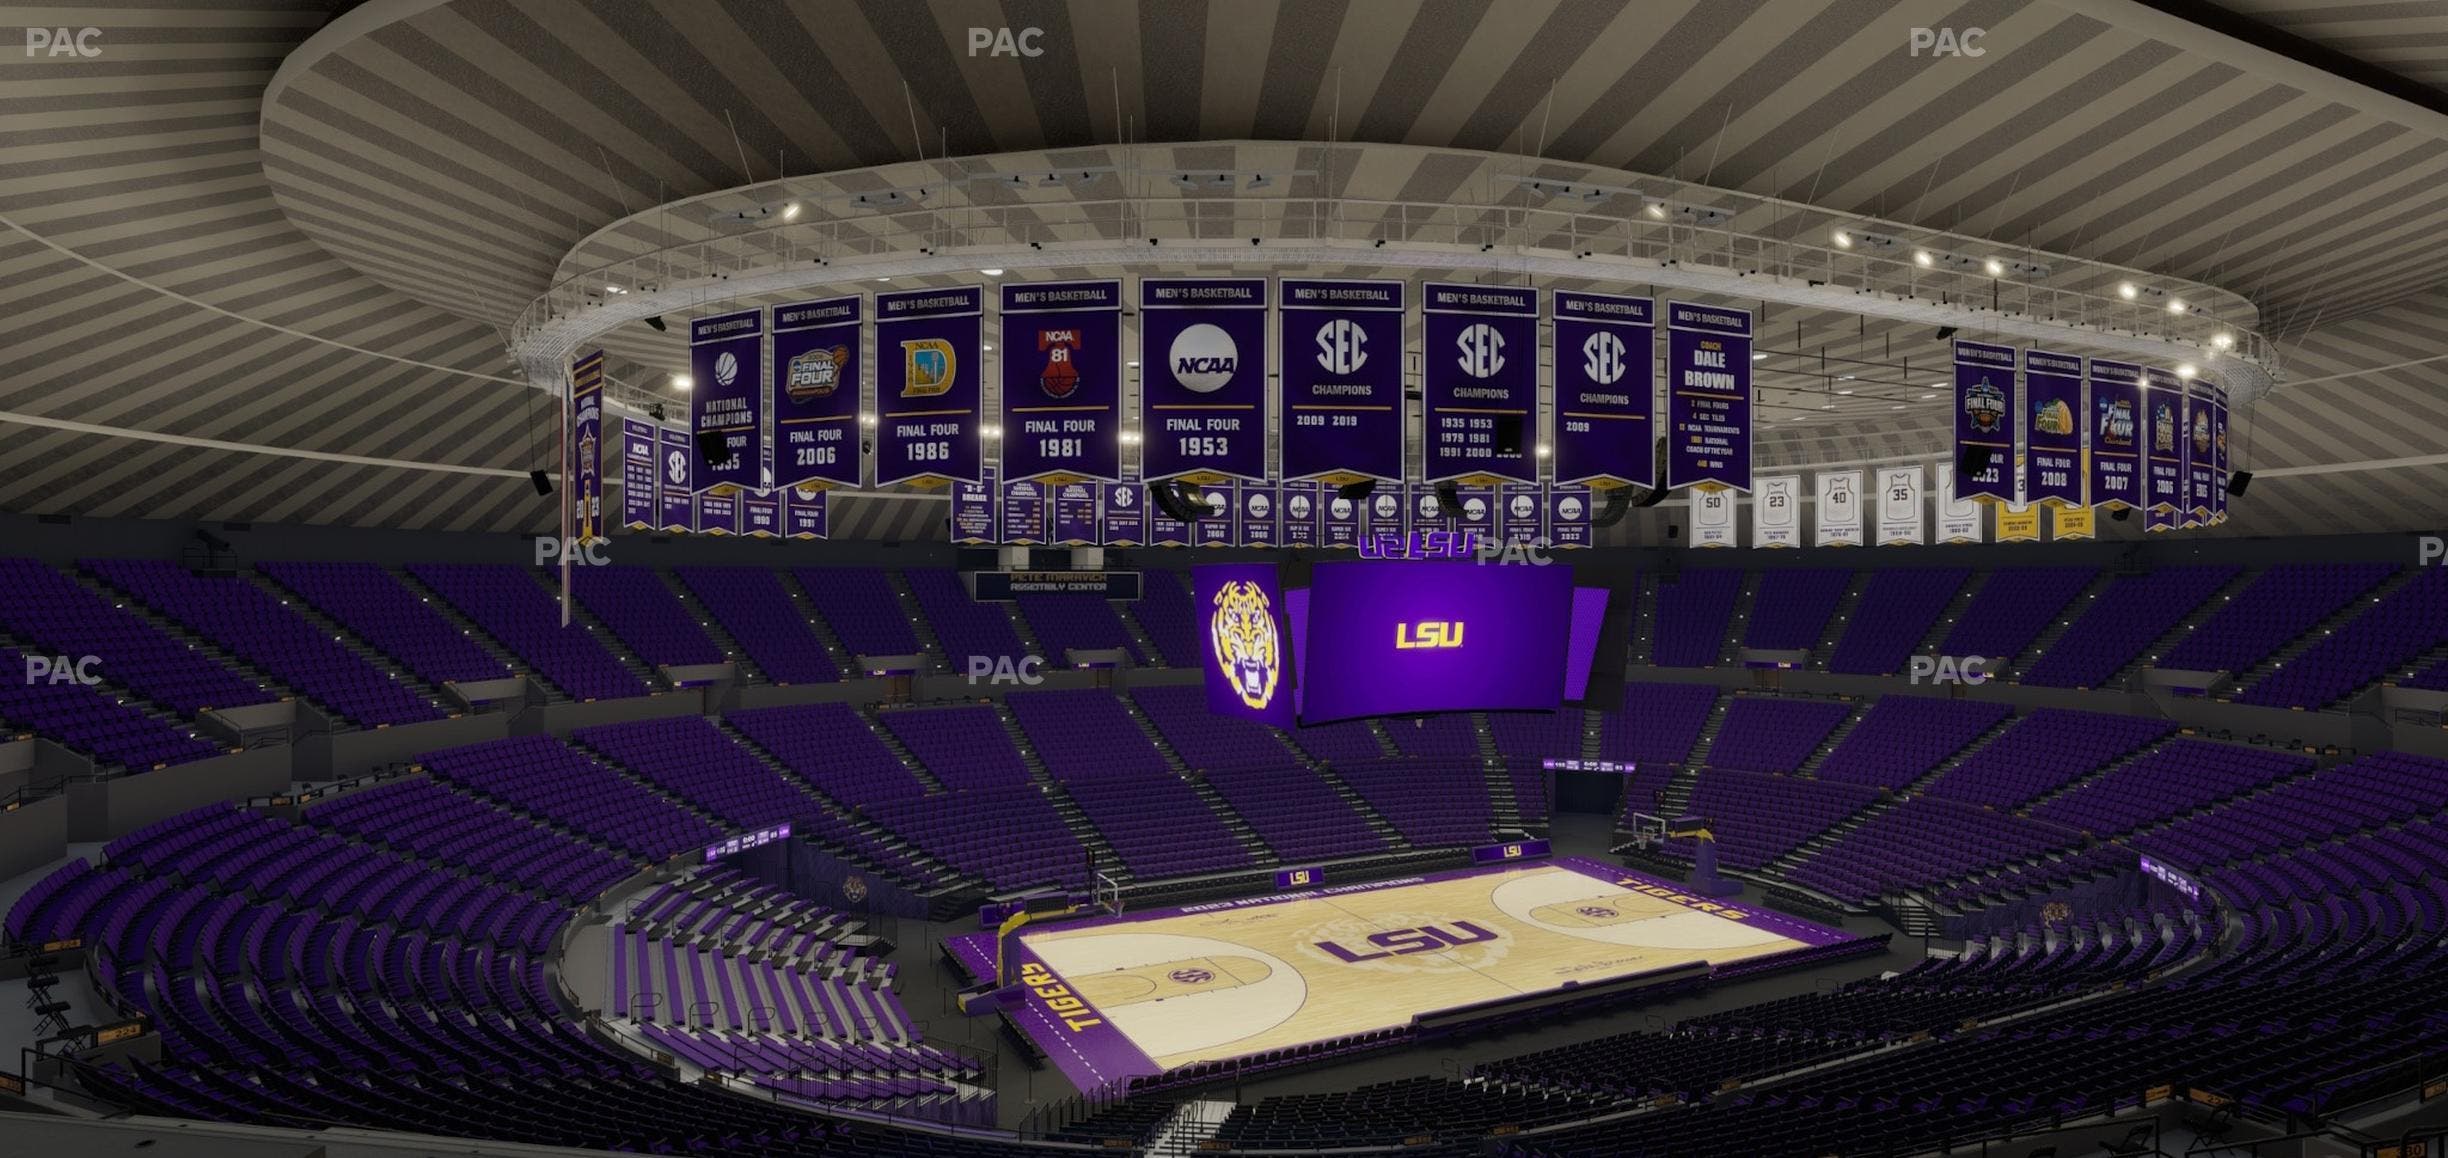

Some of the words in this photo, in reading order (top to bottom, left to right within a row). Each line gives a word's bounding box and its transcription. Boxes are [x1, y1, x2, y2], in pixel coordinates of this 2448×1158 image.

[1015, 292, 1046, 303] MEN'S
[1048, 289, 1107, 301] BASKETBALL
[1155, 288, 1189, 298] MEN'S
[1190, 288, 1252, 298] BASKETBALL
[1295, 288, 1328, 299] MEN'S
[1329, 289, 1390, 300] BASKETBALL
[1437, 292, 1469, 304] MEN'S
[1470, 294, 1526, 307] BASKETBALL
[887, 300, 915, 311] MEN'S
[917, 296, 969, 309] BASKETBALL
[1565, 300, 1593, 313] MEN'S
[1594, 302, 1643, 317] BASKETBALL
[782, 310, 806, 323] MEN'S
[807, 305, 851, 320] BASKETBALL
[1678, 310, 1701, 323] MEN'S
[1702, 313, 1743, 328] BASKETBALL
[698, 322, 718, 335] MEN'S
[718, 319, 754, 332] BASKETBALL
[1045, 330, 1073, 342] NCAA
[1315, 319, 1368, 375] SEC
[1456, 323, 1506, 378] SEC
[1051, 349, 1068, 362] 81
[1583, 331, 1626, 385] SEC
[1694, 350, 1726, 368] DALE
[802, 360, 833, 371] FINAL
[1177, 357, 1235, 374] NCAA
[791, 370, 833, 385] FOUR
[1684, 370, 1735, 390] BROWN
[1312, 384, 1372, 396] CHAMPIONS
[1453, 387, 1509, 399] CHAMPIONS
[705, 397, 748, 413] NATIONAL
[1580, 393, 1629, 405] CHAMPIONS
[701, 411, 753, 428] CHAMPIONS
[1025, 420, 1058, 433] FINAL
[1063, 419, 1096, 432] FOUR
[1166, 418, 1202, 431] FINAL
[1207, 418, 1240, 431] FOUR
[1297, 415, 1325, 426] 2009
[1332, 415, 1358, 426] 2019
[1441, 418, 1465, 428] 1935
[1470, 419, 1493, 429] 1953
[896, 425, 926, 437] FINAL
[930, 423, 959, 436] FOUR
[1566, 421, 1590, 433] 2009
[726, 435, 747, 448] FOUR
[790, 431, 815, 443] FINAL
[817, 429, 842, 441] FOUR
[1441, 433, 1464, 443] 1979
[1469, 434, 1490, 443] 1981
[907, 442, 949, 461] 1986
[1040, 438, 1082, 458] 1981
[1179, 437, 1228, 456] 1953
[1440, 447, 1461, 457] 1991
[1466, 448, 1492, 458] 2000
[796, 447, 836, 466] 2006
[2036, 457, 2054, 467] FINAL
[2100, 462, 2116, 472] FINAL
[2117, 462, 2132, 473] FOUR
[2105, 476, 2128, 490] 2007
[1114, 486, 1133, 507] SEC
[1769, 496, 1784, 507] 23
[1832, 492, 1846, 503] 40
[1893, 489, 1908, 500] 35
[1706, 497, 1720, 508] 50
[1010, 572, 1046, 582] PETE
[1048, 572, 1107, 582] MARAVICH
[1010, 582, 1065, 591] ASSEMBLY
[1068, 582, 1107, 591] CENTER
[1396, 621, 1464, 649] LSU
[1503, 844, 1521, 858] LSU
[1289, 870, 1309, 885] LSU
[1235, 890, 1317, 906] NATIONAL
[1322, 876, 1425, 895] CHAMPIONS
[1616, 877, 1750, 920] TIGERS
[1314, 921, 1498, 963] LSU
[1022, 962, 1101, 1032] TIGERS
